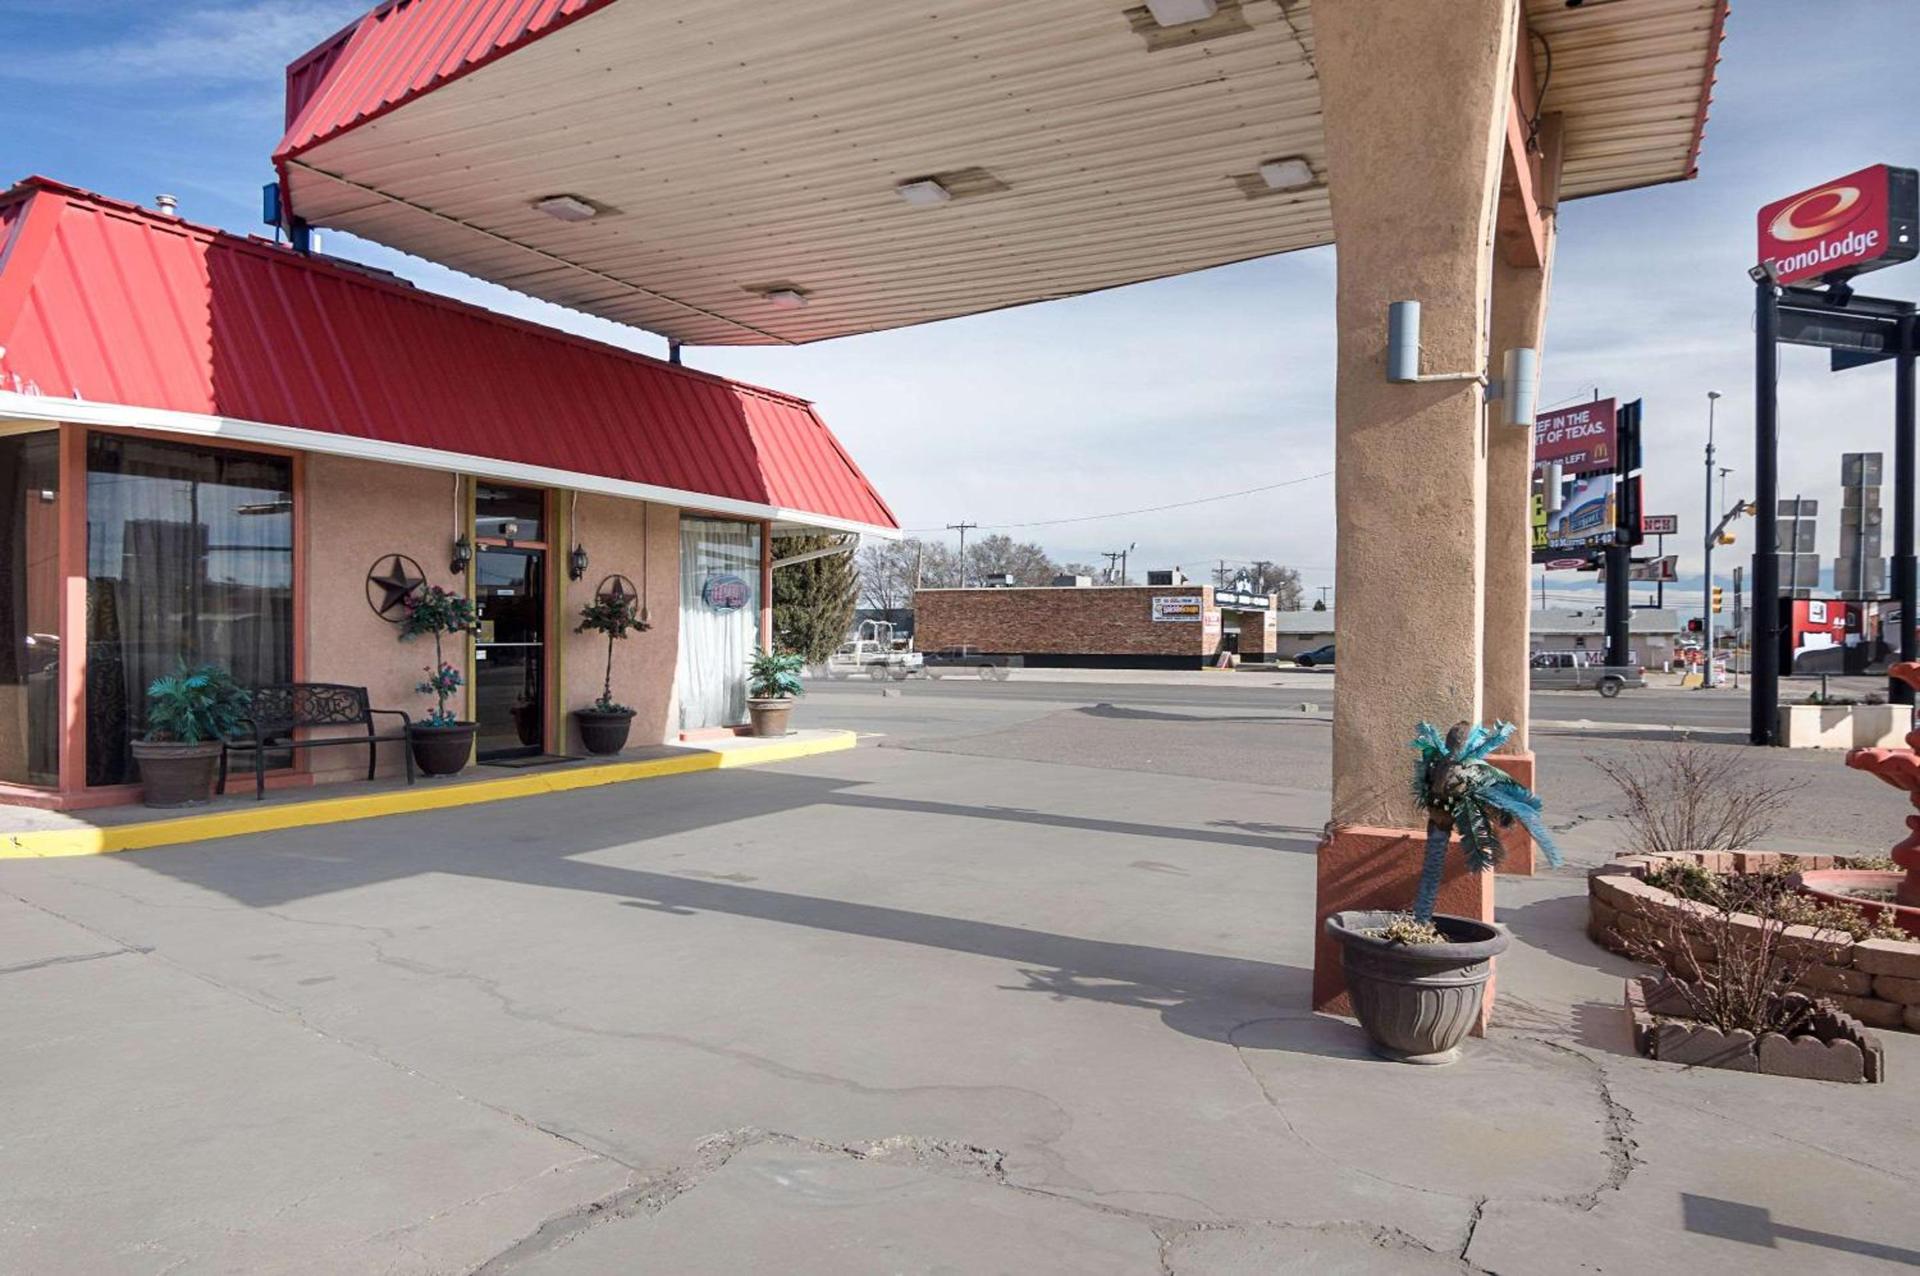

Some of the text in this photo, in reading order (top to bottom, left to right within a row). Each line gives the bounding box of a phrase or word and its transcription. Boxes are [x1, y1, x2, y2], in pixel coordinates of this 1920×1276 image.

[1764, 230, 1878, 275] conoLodge
[1553, 415, 1565, 430] IN
[1567, 411, 1590, 426] THE
[1547, 429, 1563, 443] OF
[1565, 421, 1606, 440] TEXAS.
[1565, 453, 1586, 464] LEFT
